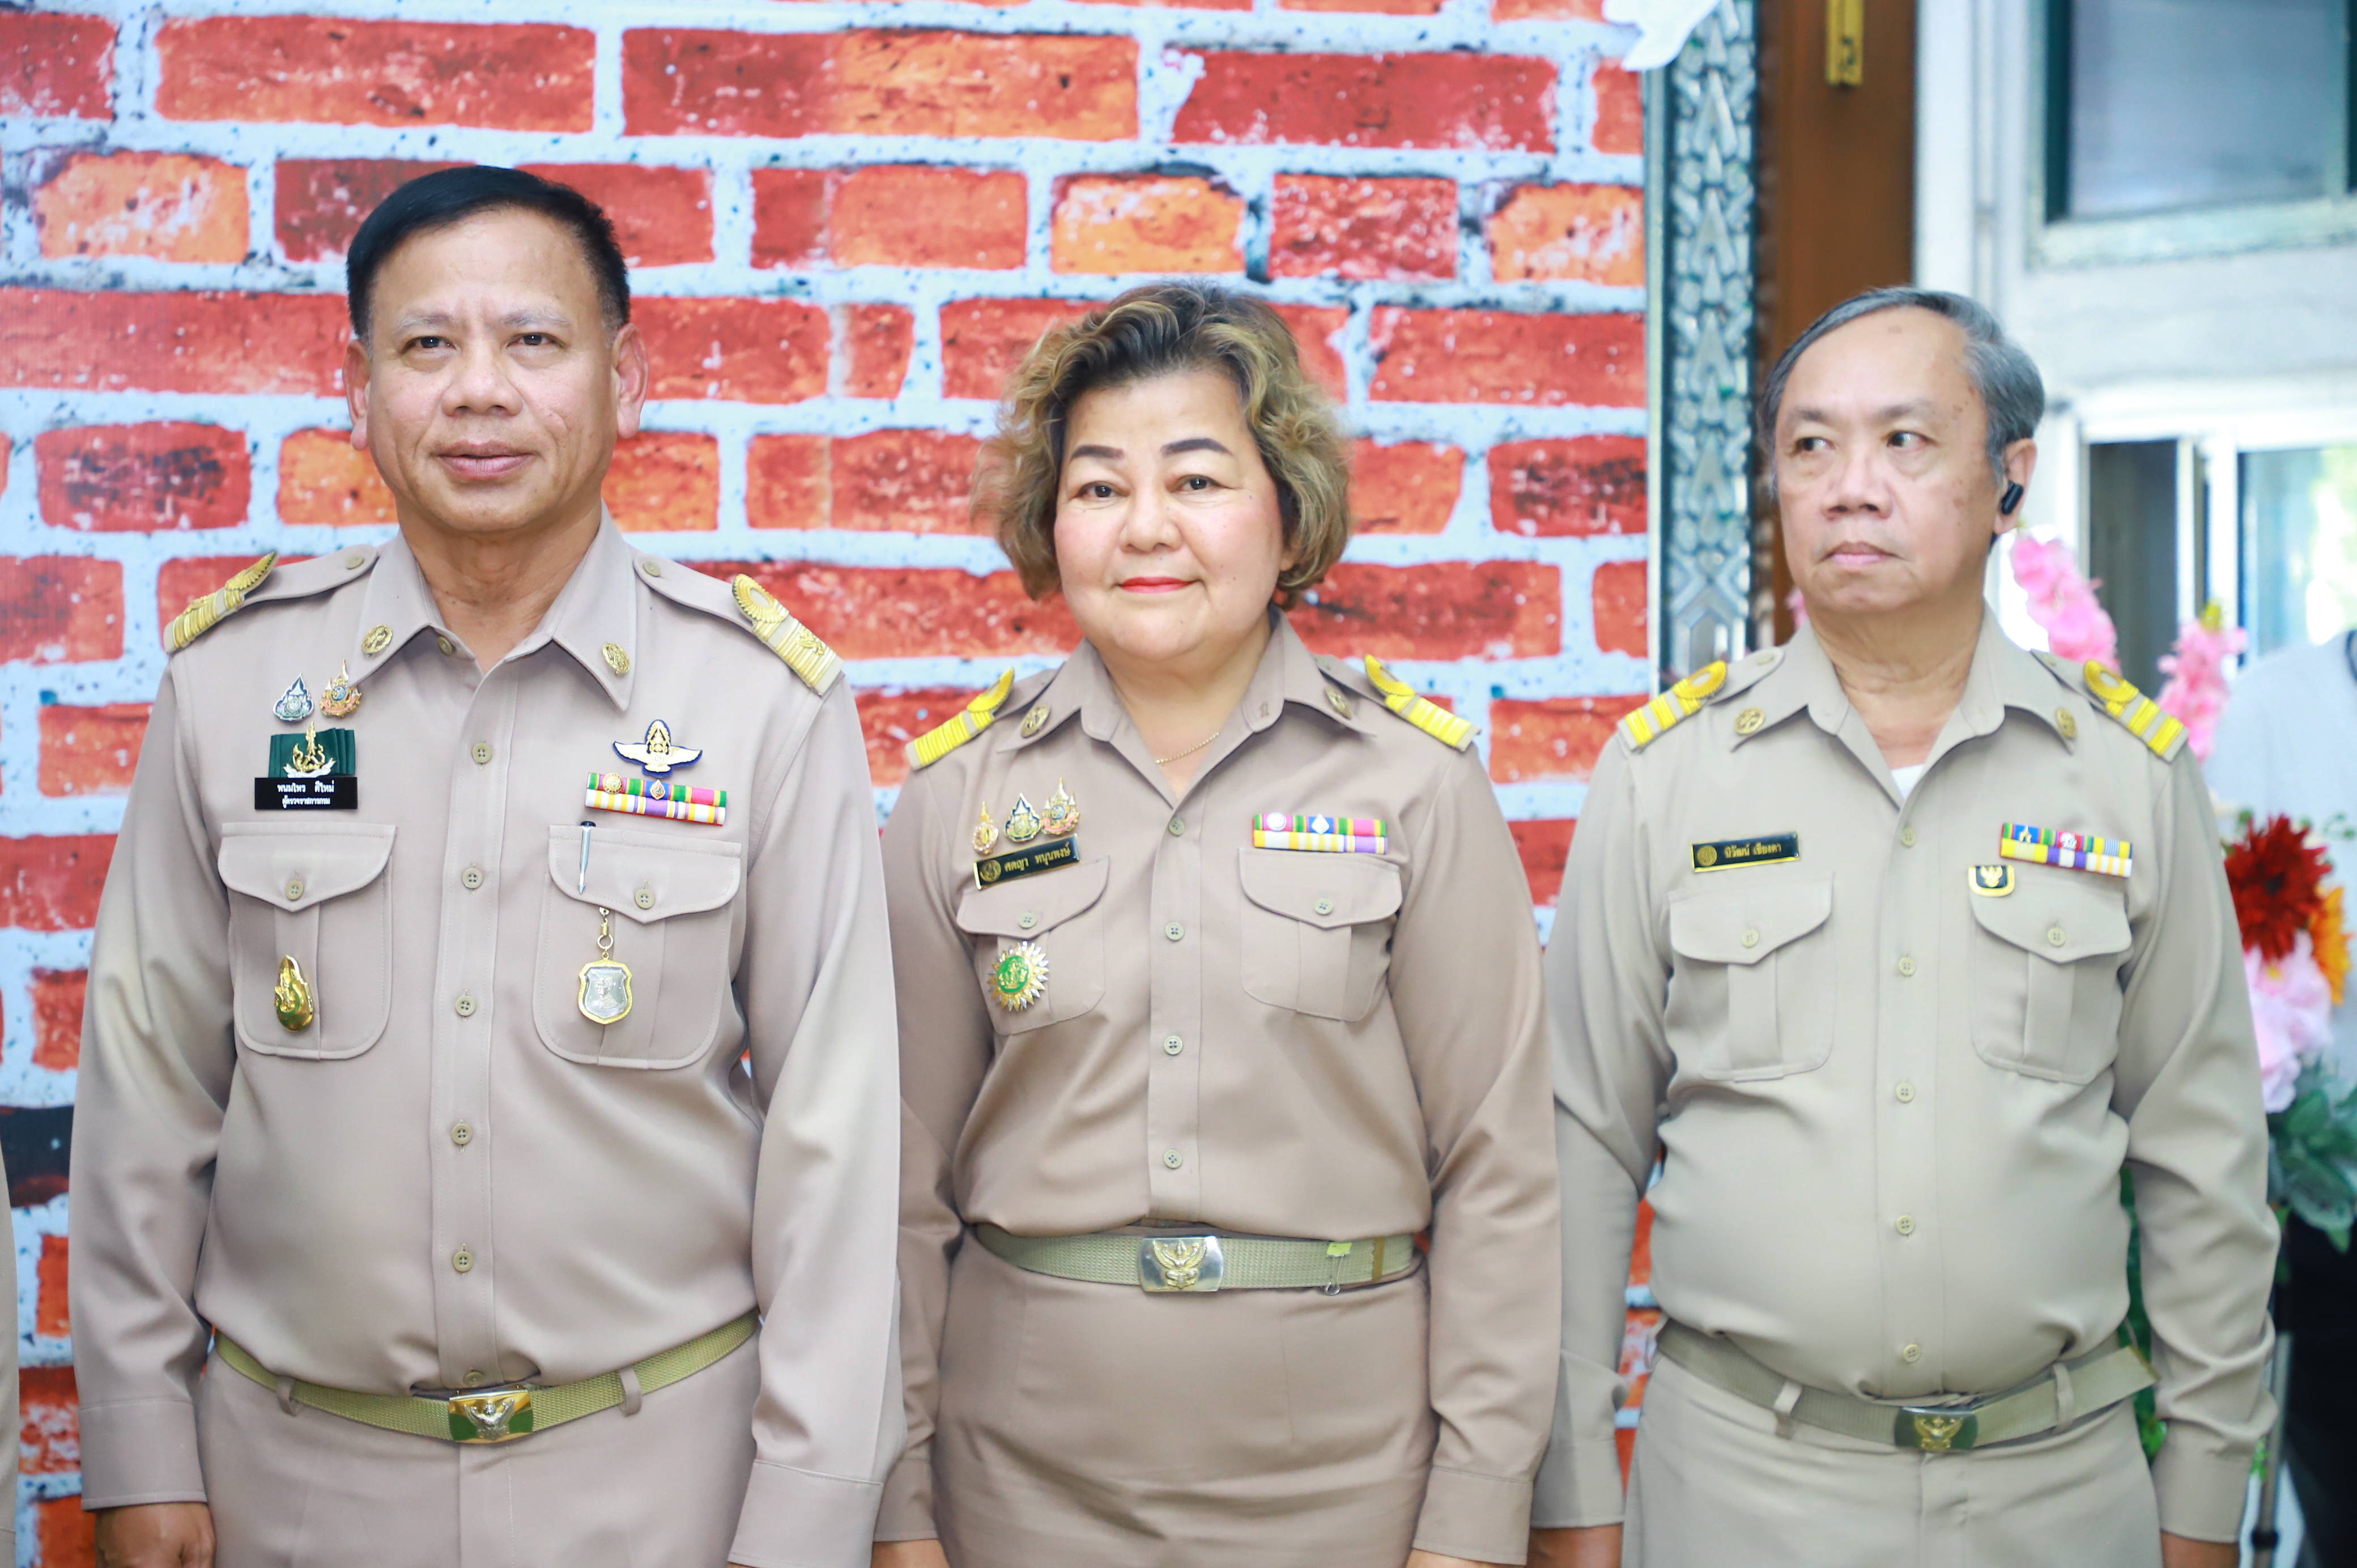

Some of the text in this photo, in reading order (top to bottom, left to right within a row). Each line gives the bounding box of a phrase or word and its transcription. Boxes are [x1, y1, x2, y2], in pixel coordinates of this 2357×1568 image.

[277, 782, 306, 793] พนมไพร
[282, 794, 330, 809] ผู้ตรวจราชการกรม
[1724, 843, 1750, 858] นิวัฒน์
